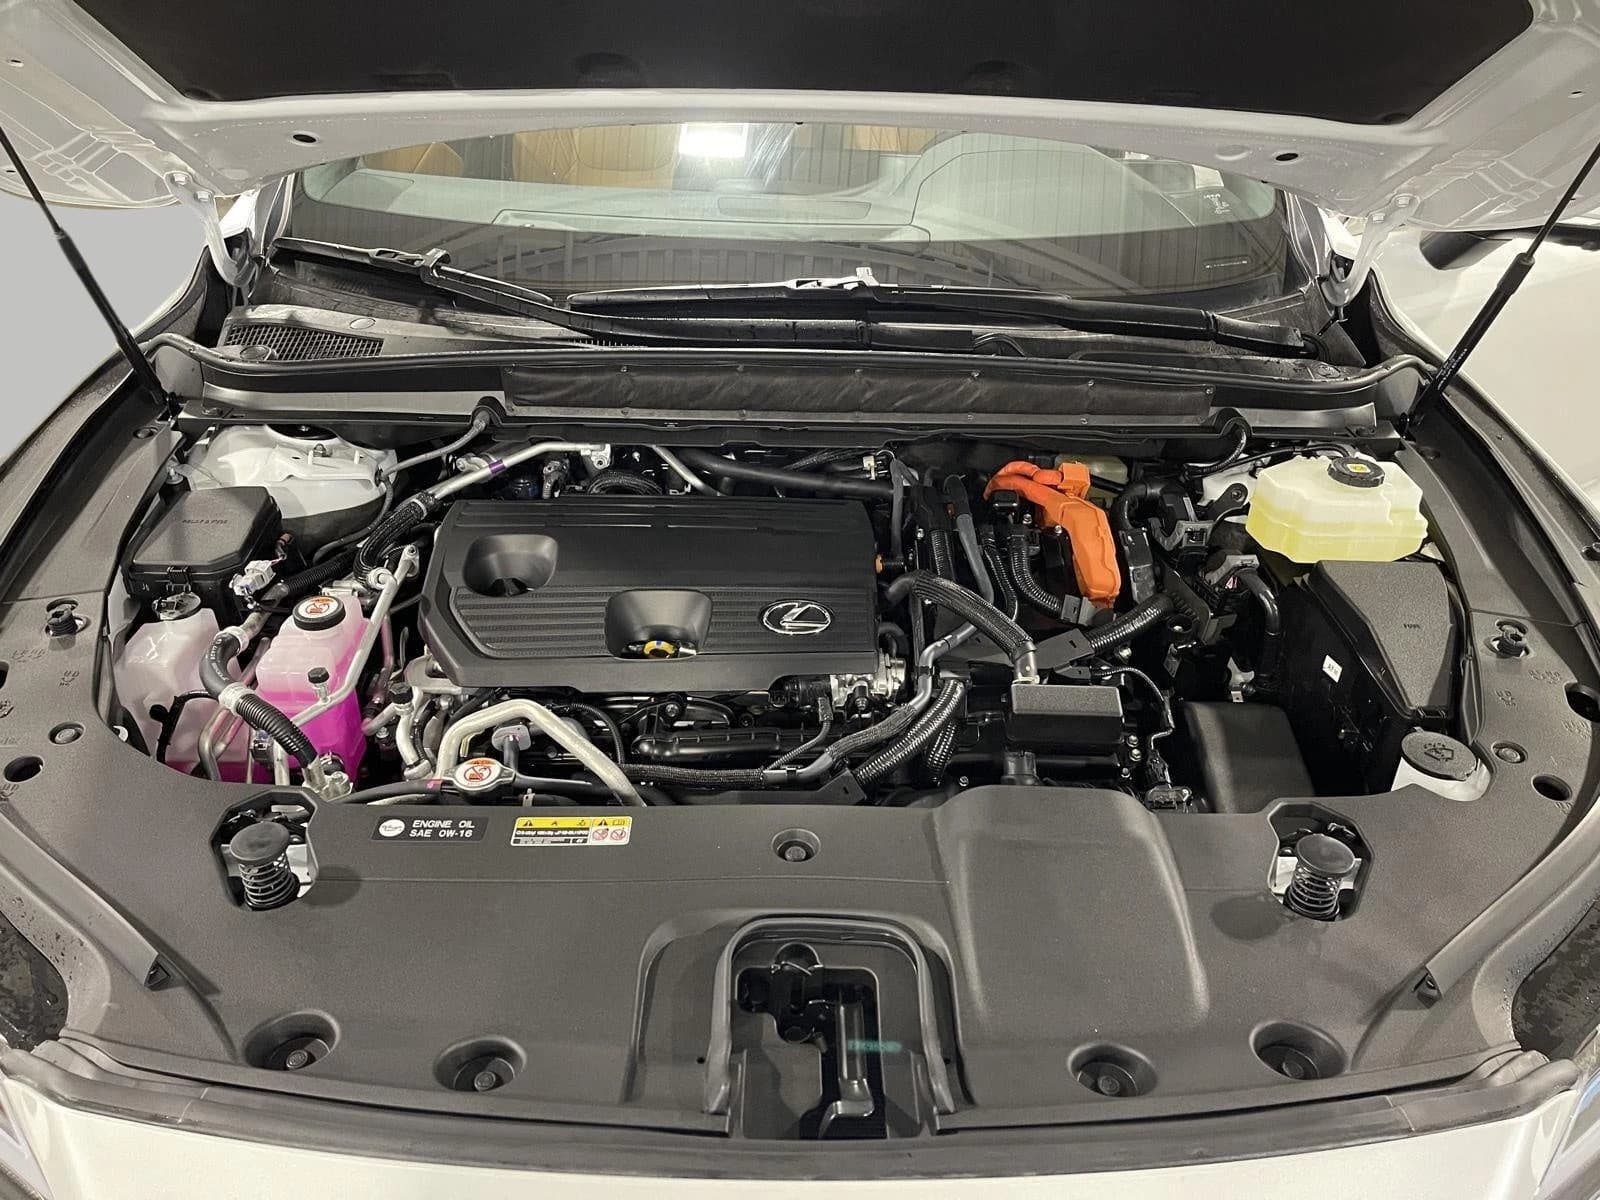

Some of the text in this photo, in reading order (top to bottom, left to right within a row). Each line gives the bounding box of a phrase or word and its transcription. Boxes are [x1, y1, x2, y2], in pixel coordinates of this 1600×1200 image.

[412, 820, 452, 828] ENGINE
[458, 820, 475, 828] OIL
[409, 829, 432, 837] SAE
